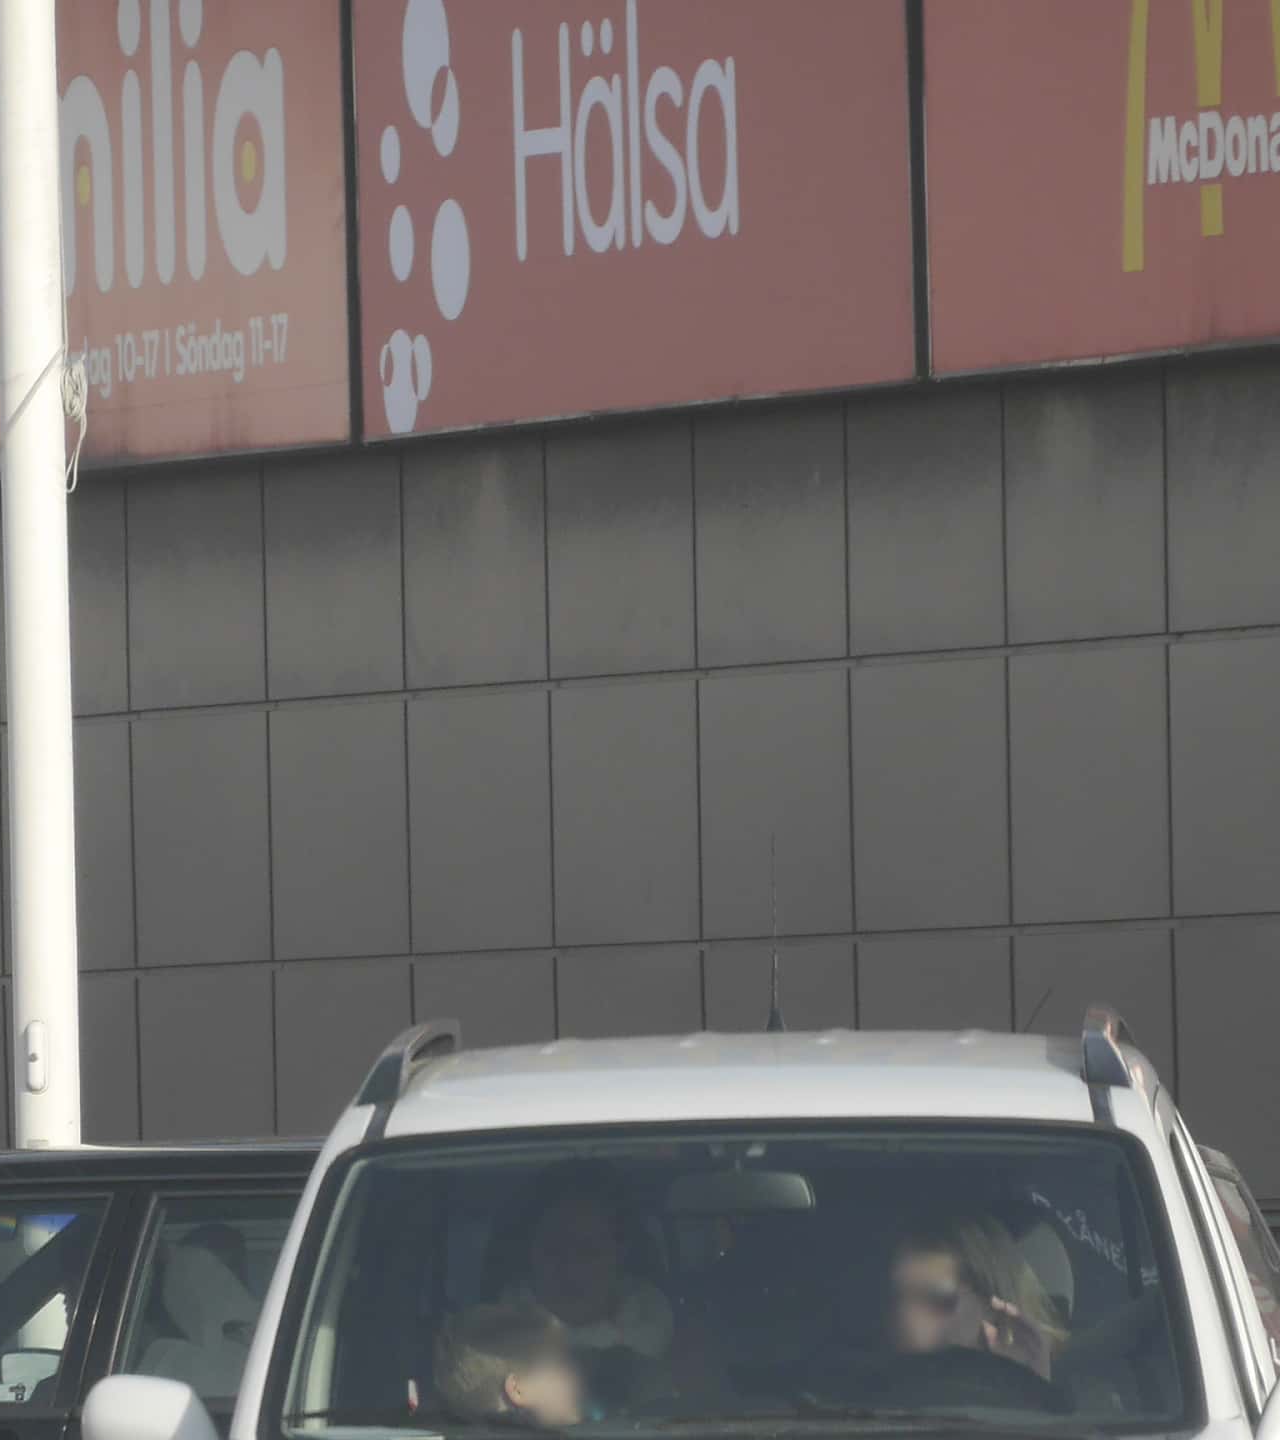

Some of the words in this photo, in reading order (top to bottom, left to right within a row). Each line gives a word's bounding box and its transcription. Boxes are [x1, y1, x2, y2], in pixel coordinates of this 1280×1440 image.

[511, 0, 738, 262] Hälsa
[116, 329, 160, 383] 10-17
[176, 319, 245, 384] Söndag
[249, 313, 288, 368] 11-17
